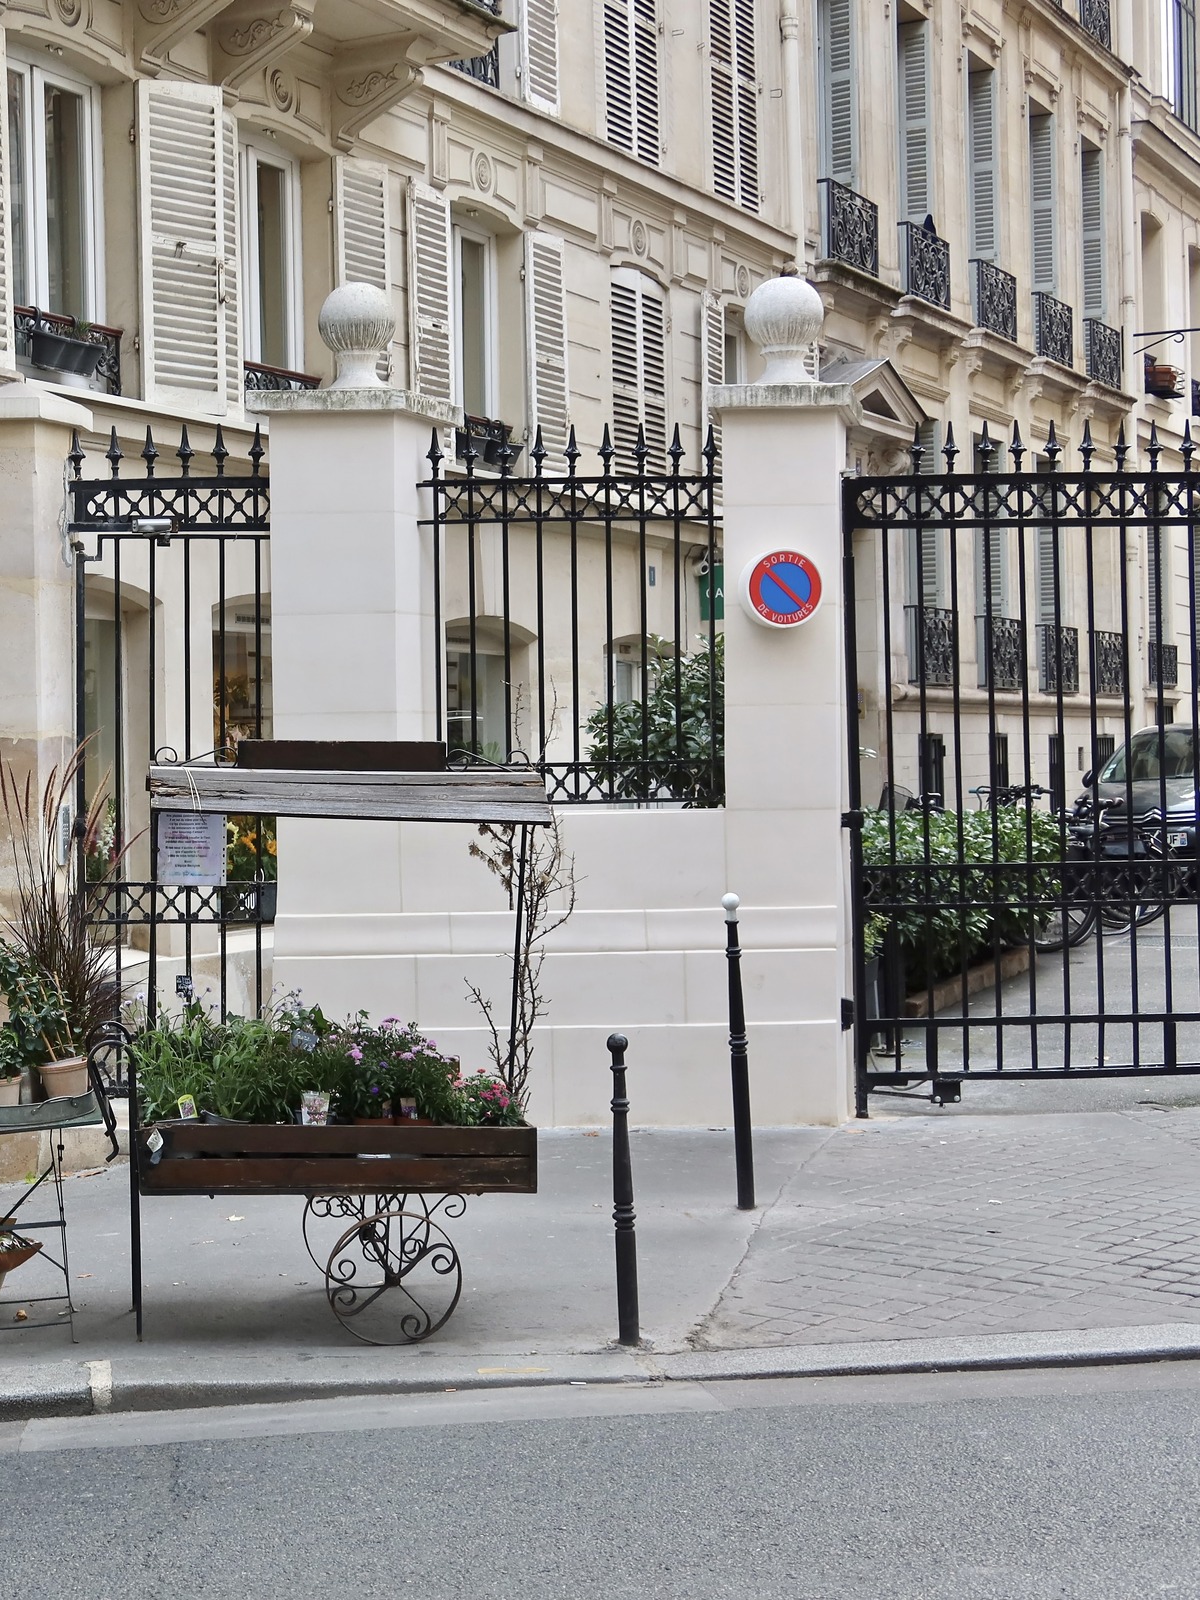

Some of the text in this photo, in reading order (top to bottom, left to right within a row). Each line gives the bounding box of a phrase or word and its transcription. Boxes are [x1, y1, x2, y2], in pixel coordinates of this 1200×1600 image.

[763, 554, 806, 568] SORTIE
[757, 603, 814, 623] DE VOITURES
